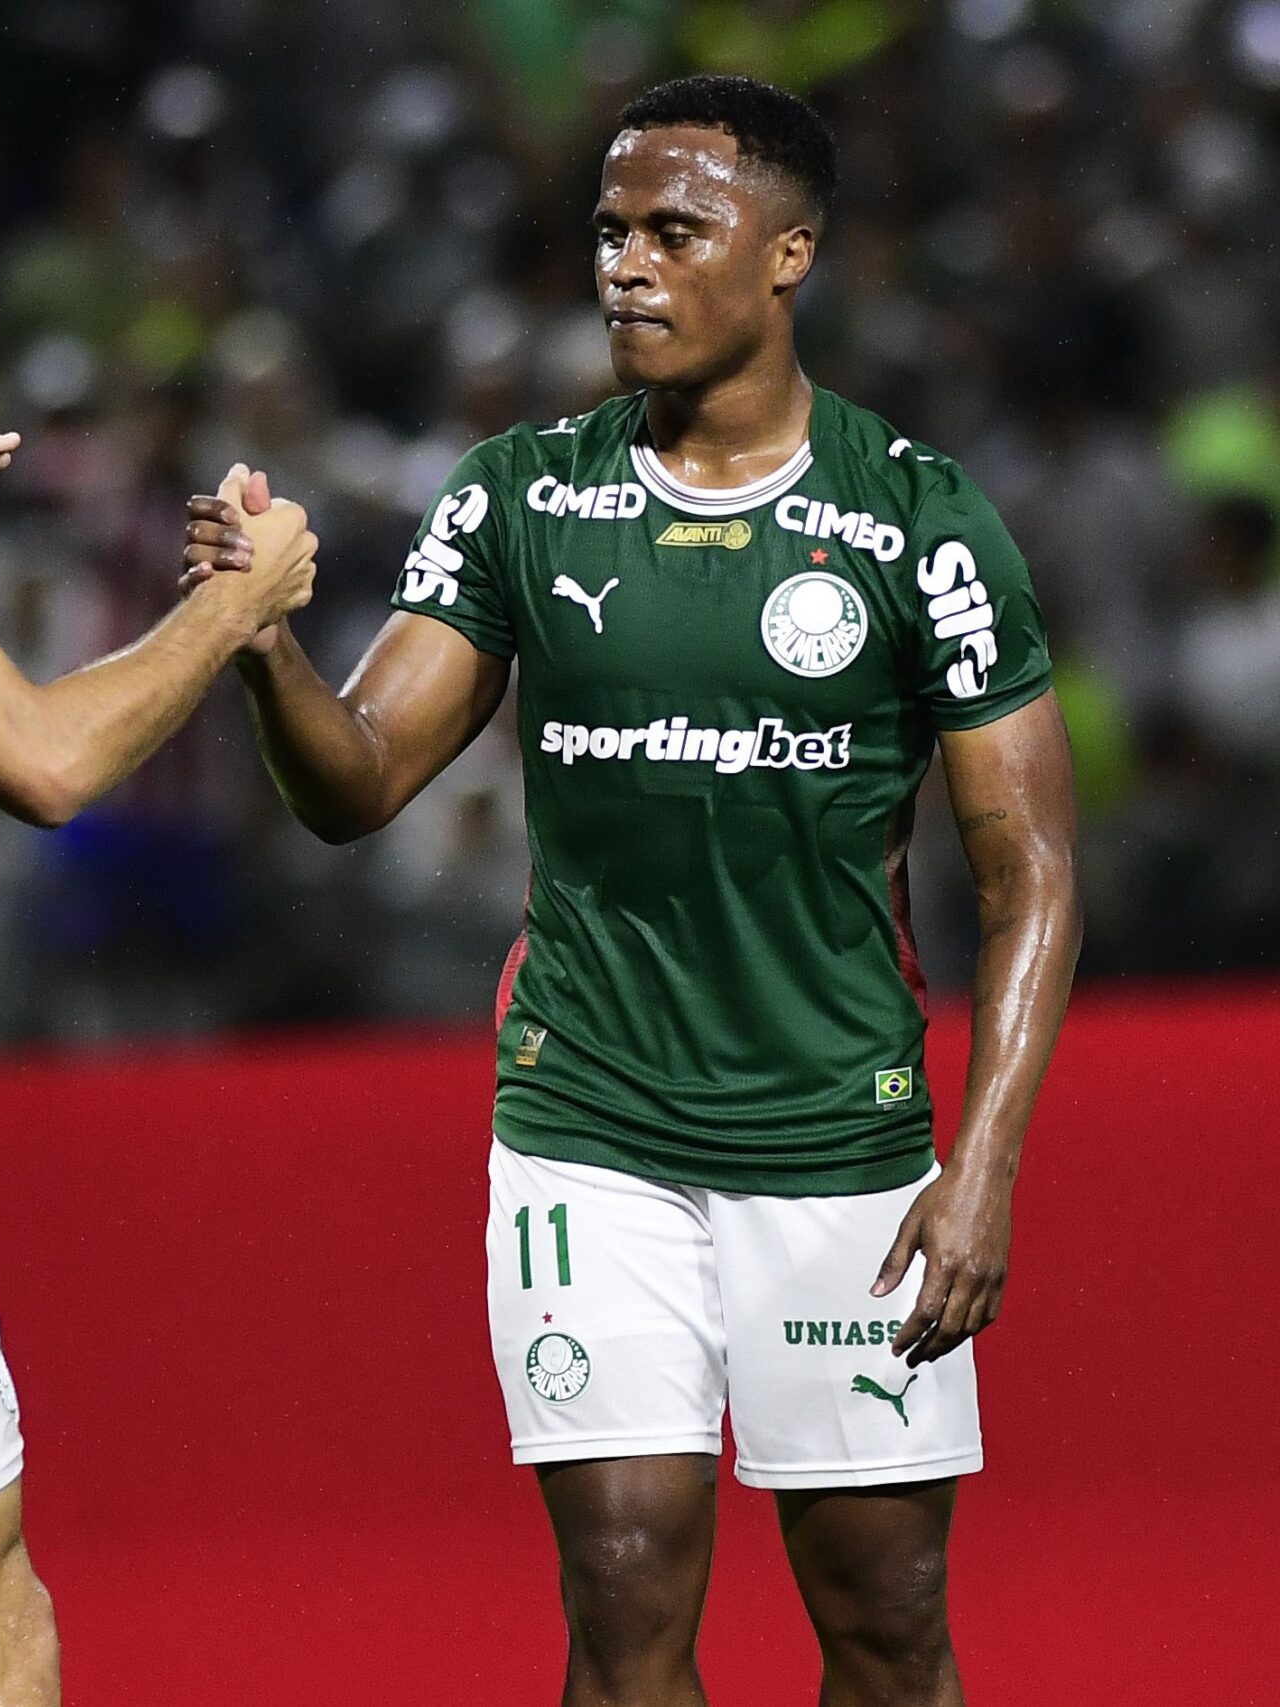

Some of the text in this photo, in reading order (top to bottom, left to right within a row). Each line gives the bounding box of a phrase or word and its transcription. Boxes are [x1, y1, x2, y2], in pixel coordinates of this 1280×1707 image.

[527, 475, 647, 519] CIMED
[665, 526, 722, 543] AVANTI
[775, 495, 905, 562] CIMED
[769, 615, 860, 671] PALMEIRAS
[541, 717, 853, 774] sportingbet
[515, 1203, 572, 1289] 11
[528, 1358, 589, 1401] PALMEIRAS
